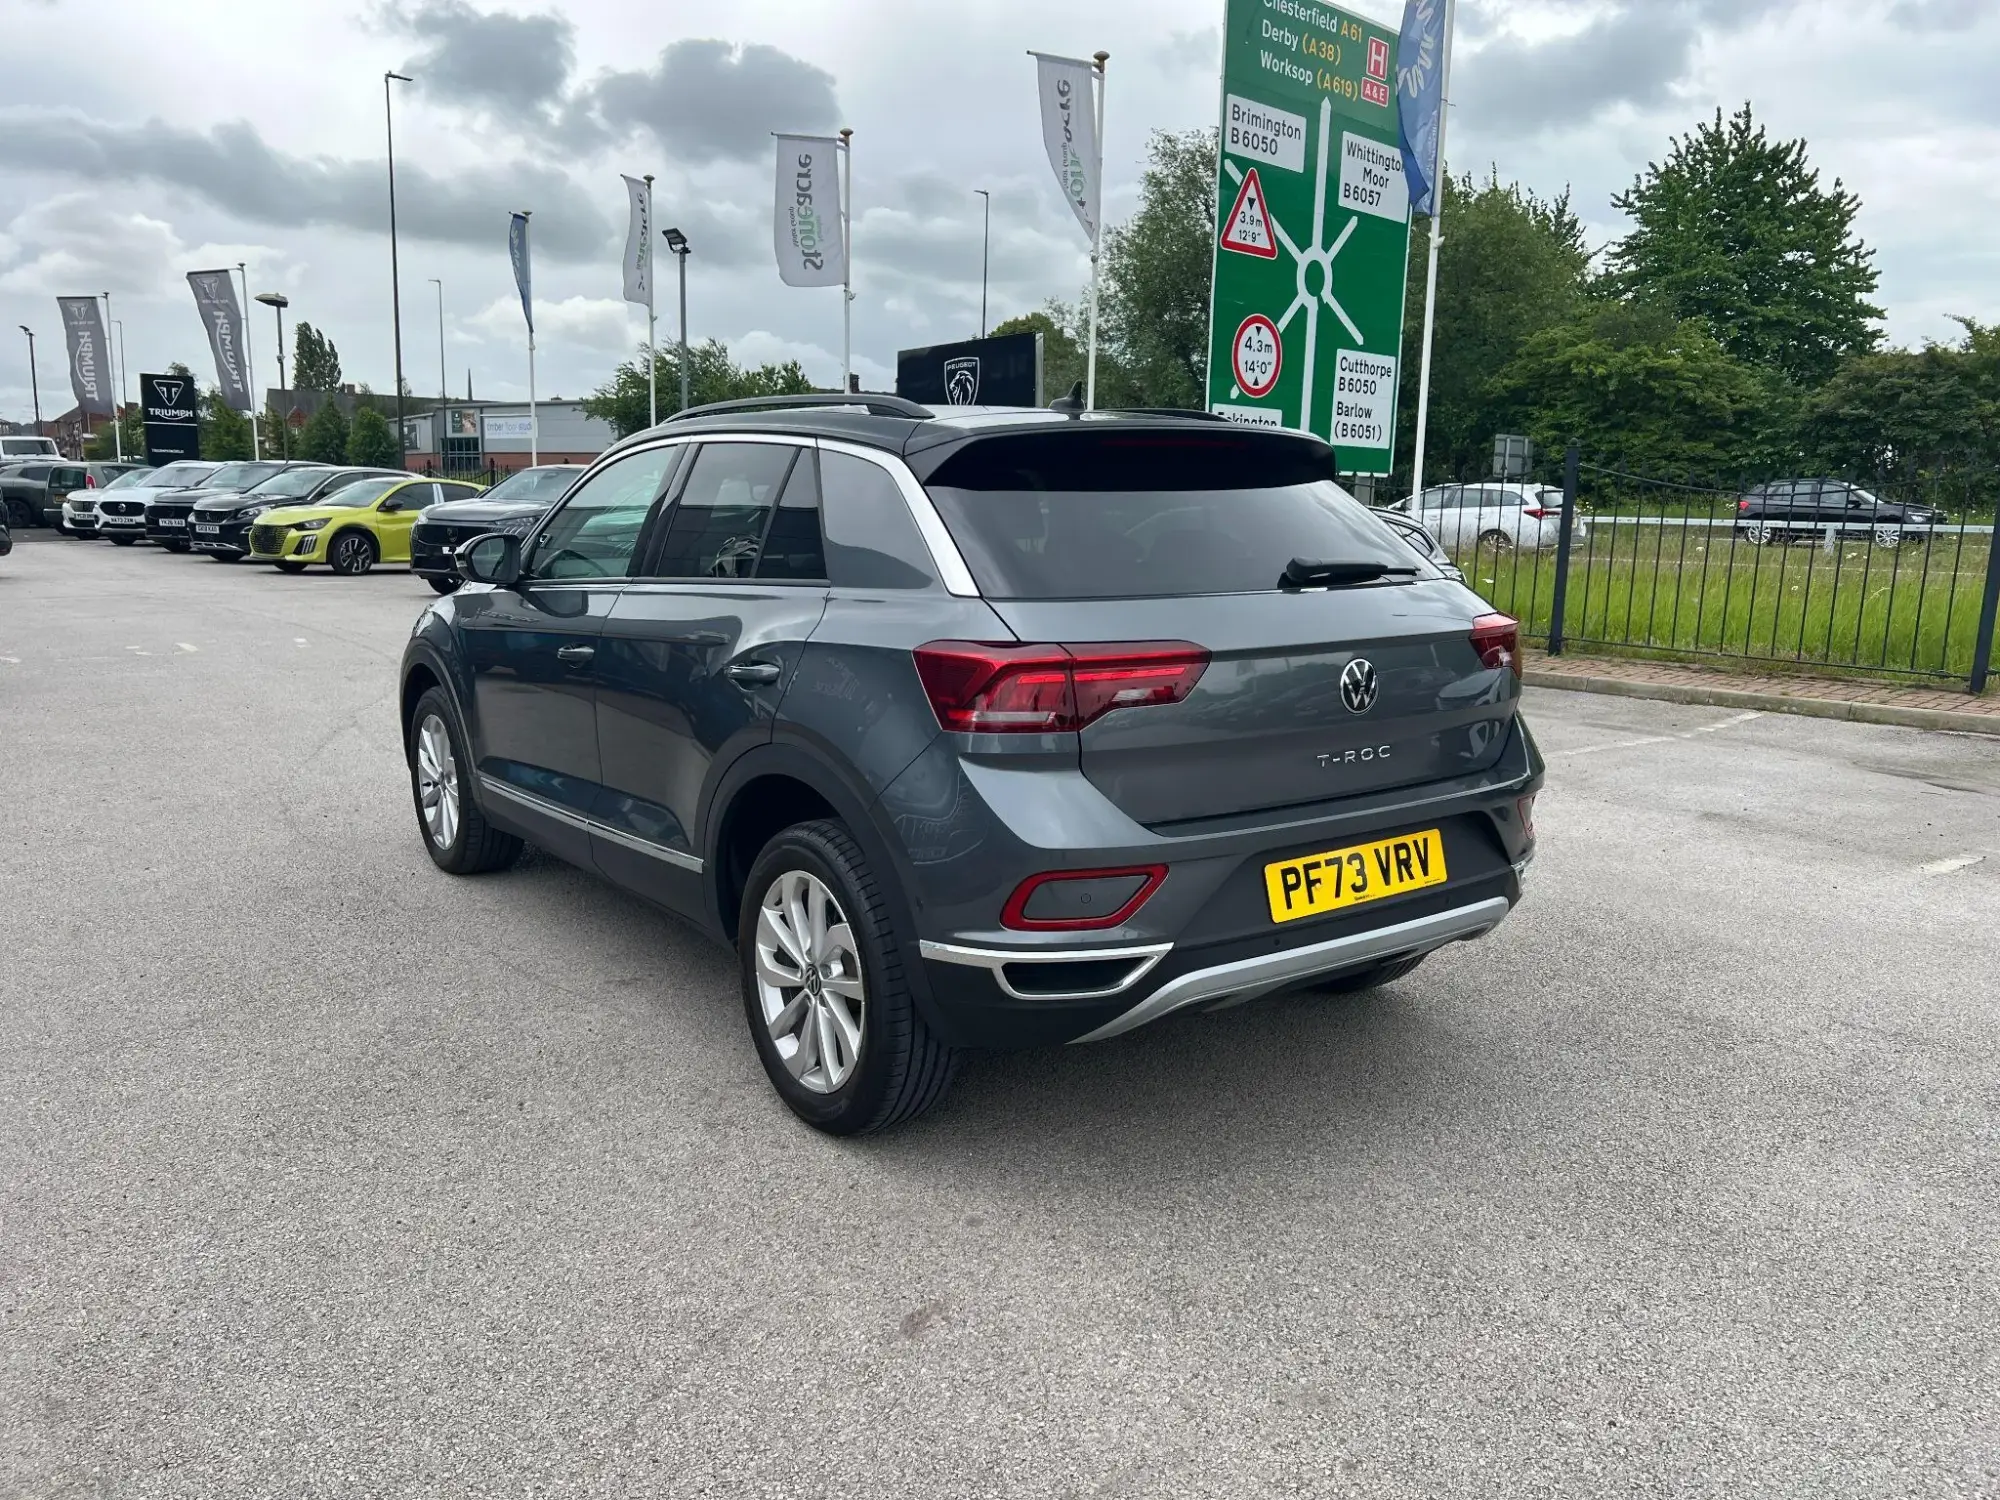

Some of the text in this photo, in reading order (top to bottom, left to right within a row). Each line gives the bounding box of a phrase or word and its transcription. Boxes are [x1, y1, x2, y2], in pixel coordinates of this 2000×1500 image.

[1262, 19, 1341, 66] Derby (A38)
[1340, 20, 1362, 43] A61
[1370, 41, 1386, 76] H
[1260, 49, 1358, 102] Worksop (A619)
[1364, 83, 1386, 102] A&E
[1232, 103, 1301, 140] Brimington
[1231, 127, 1278, 155] B6050
[1346, 140, 1404, 172] Whittingto
[1363, 167, 1389, 189] Moor
[1343, 182, 1381, 207] B6057
[947, 361, 977, 371] PEUGEOT
[1340, 356, 1392, 379] Cutthorpe
[1338, 376, 1377, 395] B6050
[148, 407, 193, 418] TRIUMPH
[1336, 401, 1373, 419] Barlow
[1334, 420, 1382, 442] (B6051)
[1316, 745, 1391, 767] T-ROC
[1280, 837, 1431, 910] PF73 VRV
